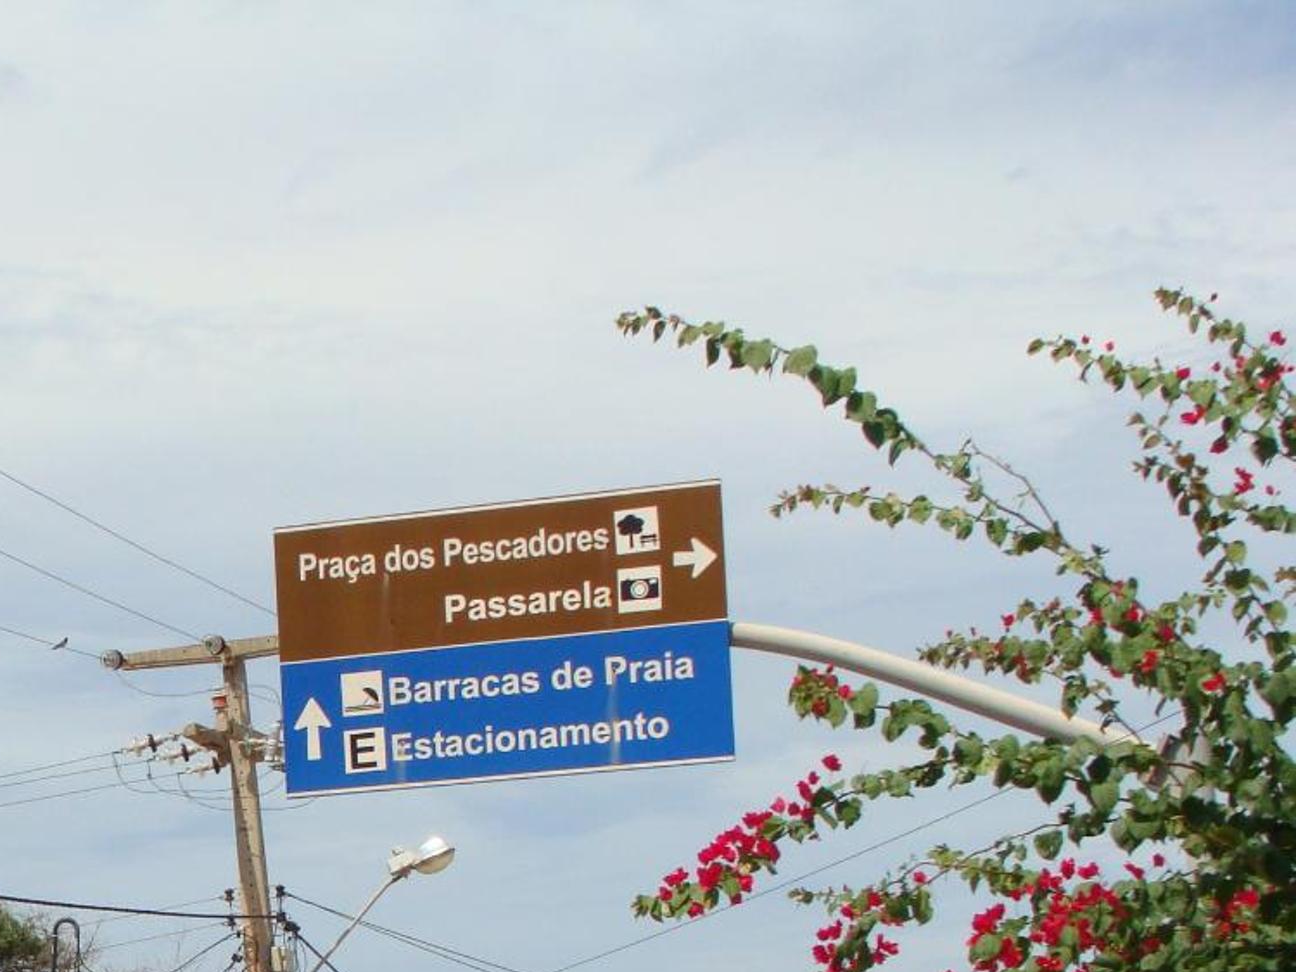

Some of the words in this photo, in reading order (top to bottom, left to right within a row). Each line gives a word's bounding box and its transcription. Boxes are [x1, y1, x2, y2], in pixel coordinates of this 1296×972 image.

[299, 553, 377, 584] Praça
[384, 544, 435, 573] dos
[443, 525, 610, 567] Pescadores
[445, 581, 612, 623] Passarela
[388, 668, 540, 706] Barracas
[551, 660, 593, 690] de
[605, 651, 695, 686] Praia
[350, 732, 378, 769] E
[392, 713, 670, 762] Estacionamento
